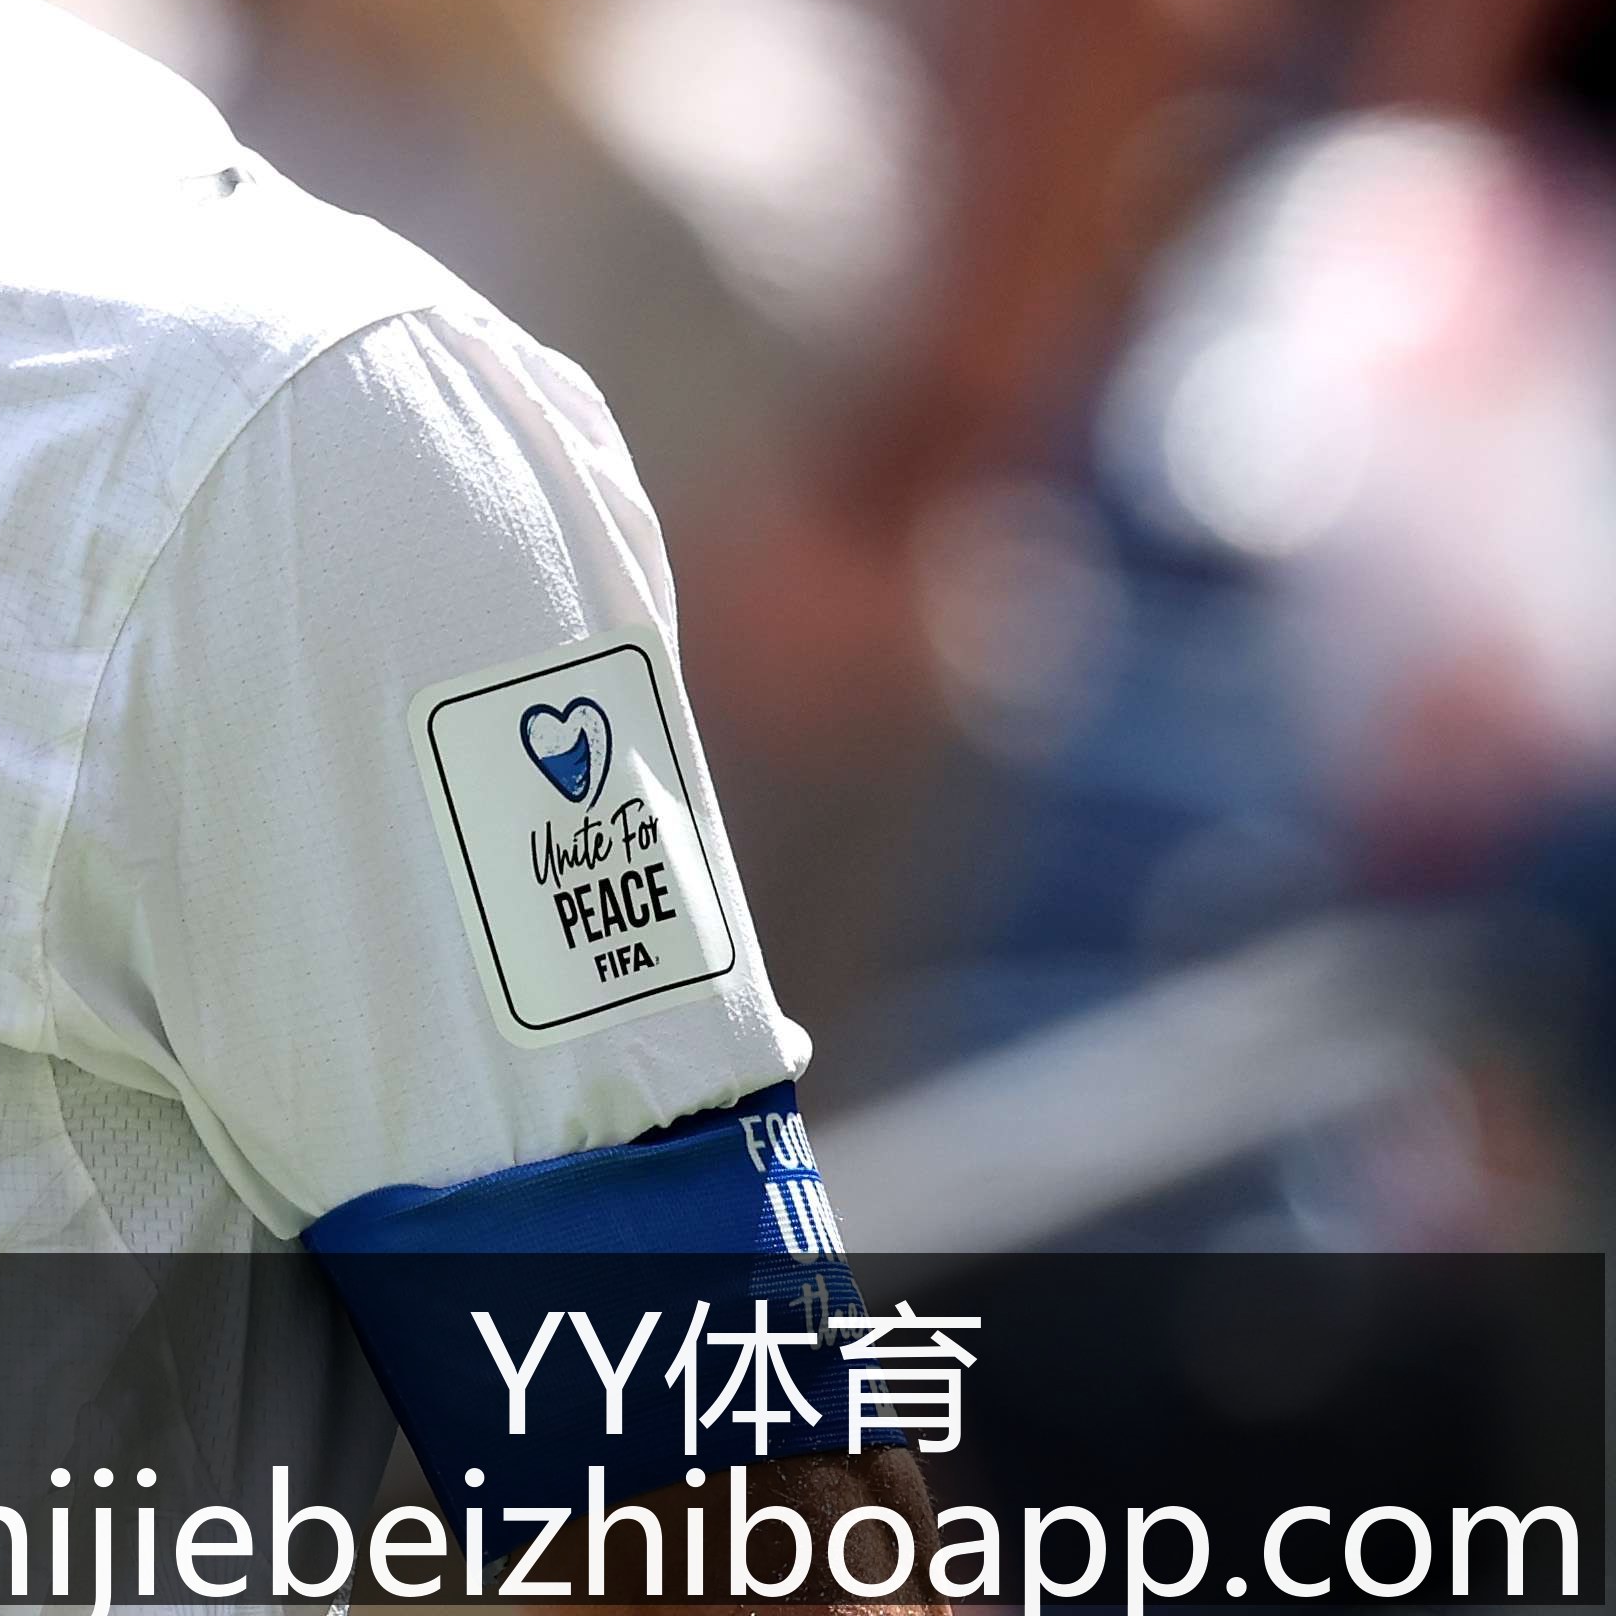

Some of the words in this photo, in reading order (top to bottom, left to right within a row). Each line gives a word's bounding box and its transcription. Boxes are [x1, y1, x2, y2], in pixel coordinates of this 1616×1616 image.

[531, 815, 613, 888] Unite
[610, 797, 659, 863] For
[553, 862, 677, 950] PEACE
[593, 941, 656, 983] FIFA
[738, 1112, 819, 1173] FOO
